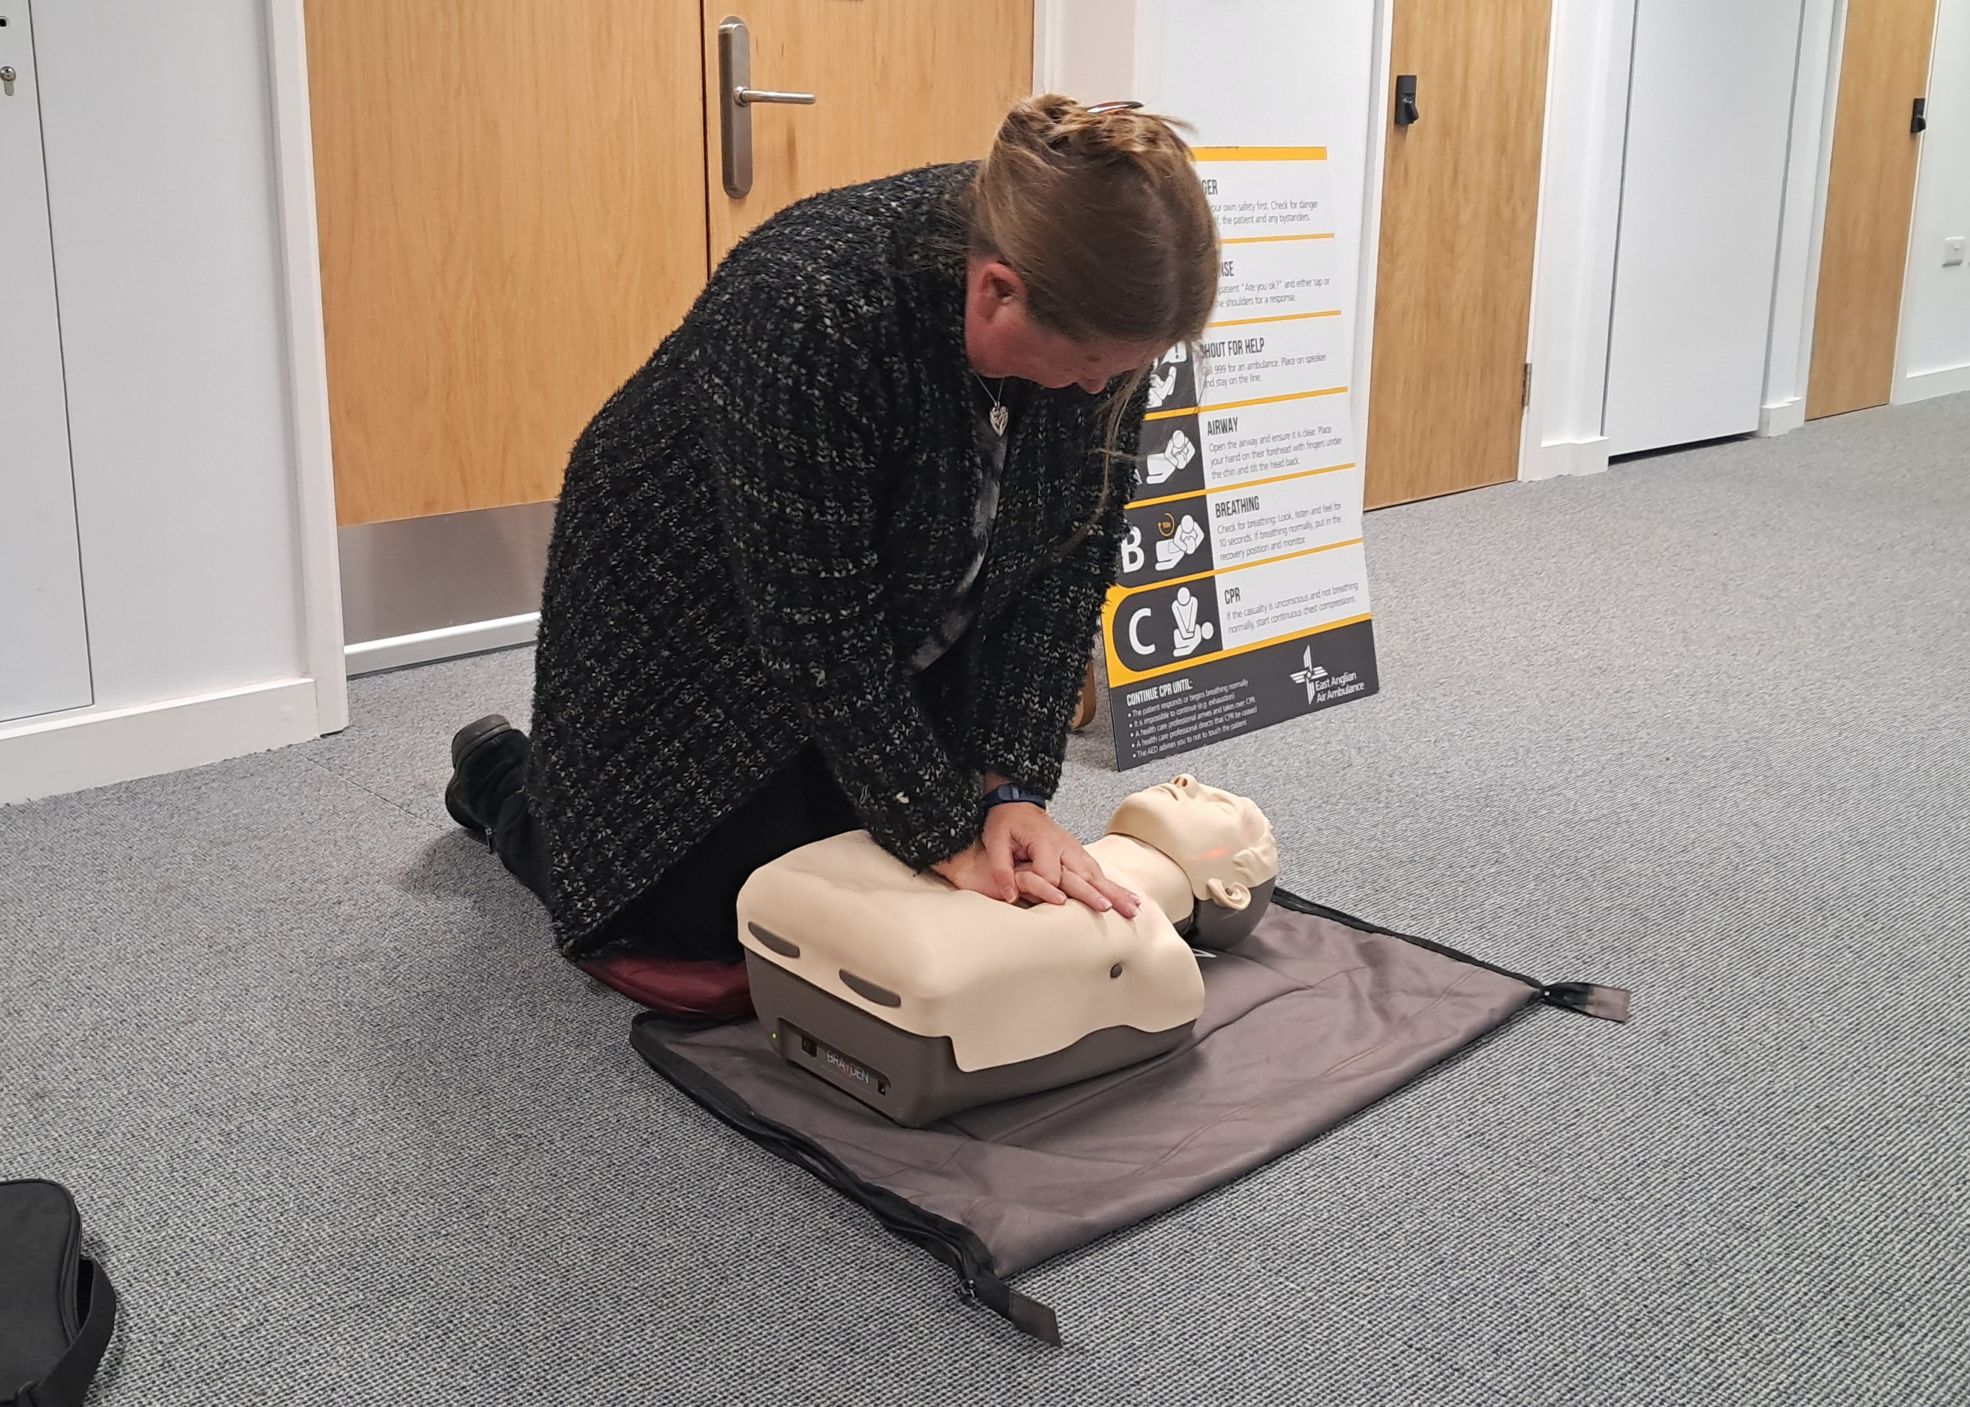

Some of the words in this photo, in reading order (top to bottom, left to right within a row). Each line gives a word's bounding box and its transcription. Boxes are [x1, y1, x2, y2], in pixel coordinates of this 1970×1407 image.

[1228, 340, 1243, 355] FOR
[1245, 338, 1264, 354] HELP
[1207, 417, 1238, 436] AIRWAY
[1215, 496, 1260, 518] BREATHING
[1120, 526, 1144, 573] B
[1224, 587, 1241, 604] CPR
[1129, 608, 1155, 655] C
[1126, 687, 1158, 706] CONTINUE
[1159, 683, 1172, 697] CPR
[1172, 678, 1193, 693] UNTIL:
[1316, 679, 1331, 691] East
[1332, 672, 1356, 686] Anglian
[1317, 692, 1326, 703] Air
[1327, 682, 1365, 700] Ambulance
